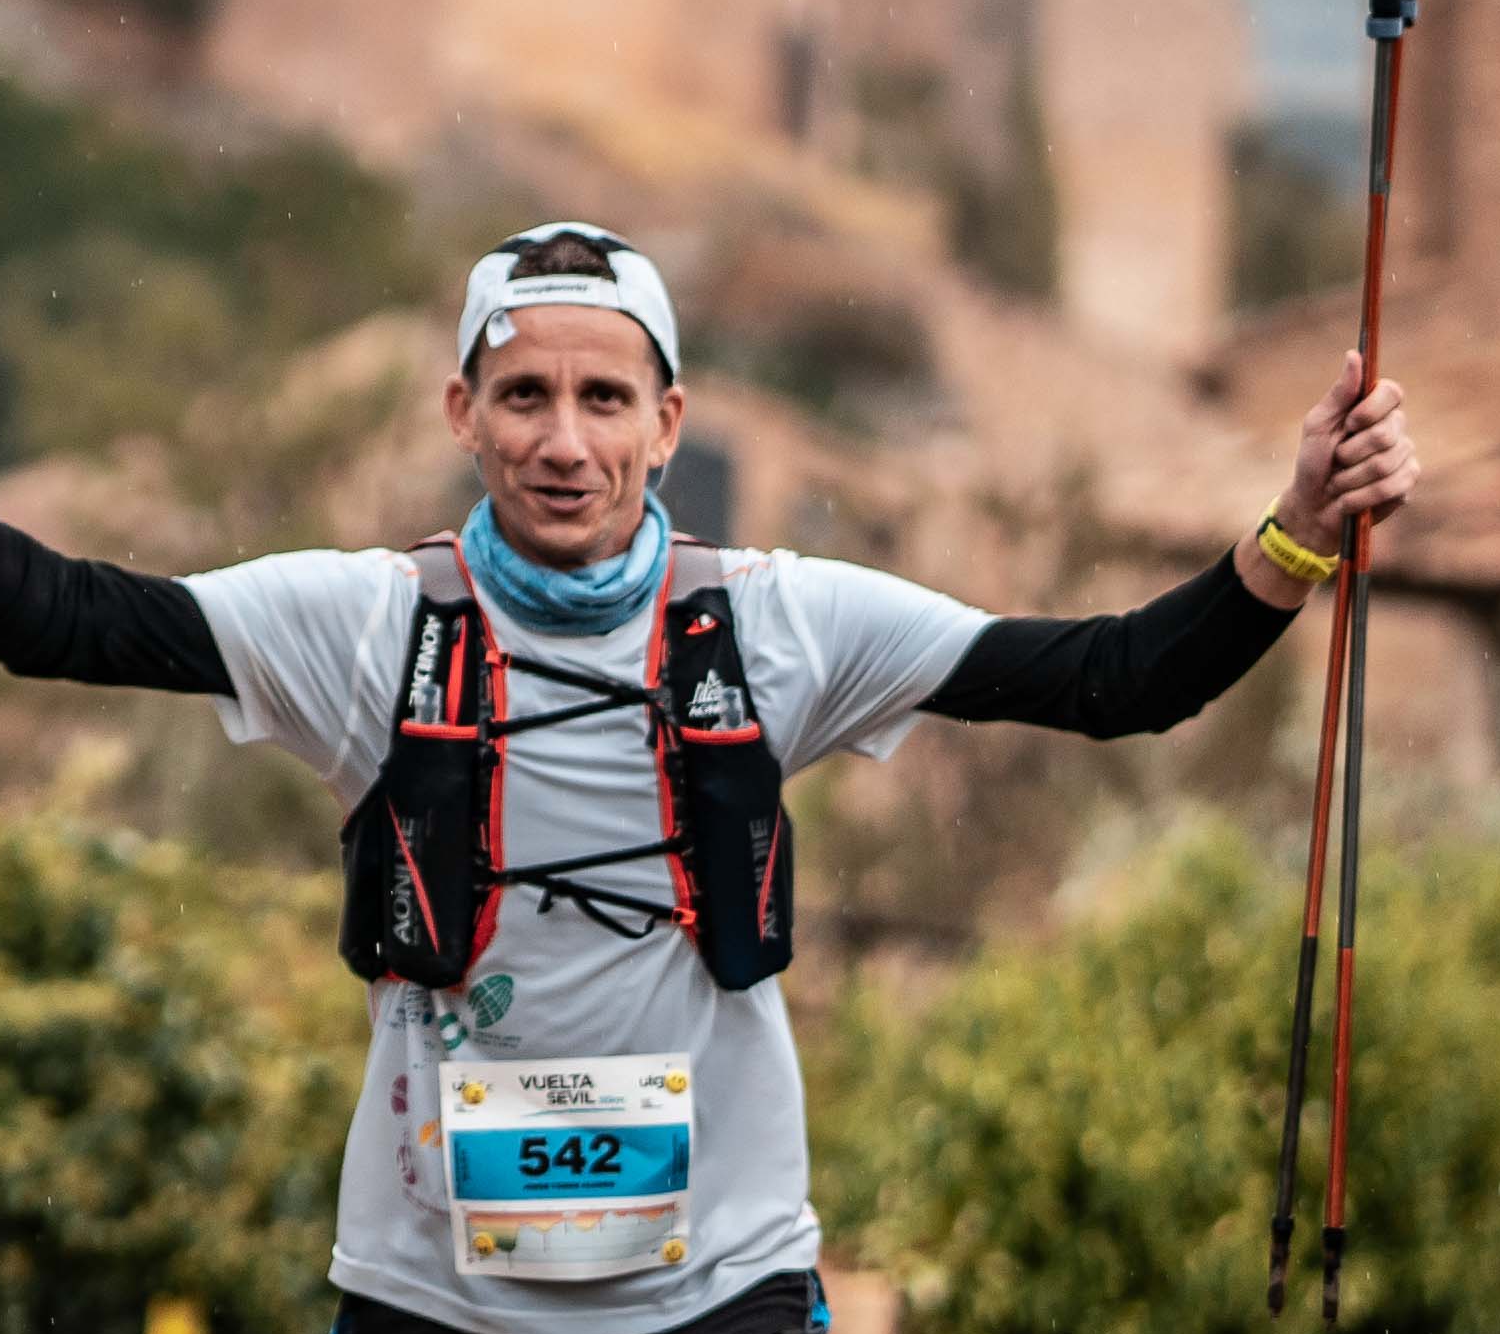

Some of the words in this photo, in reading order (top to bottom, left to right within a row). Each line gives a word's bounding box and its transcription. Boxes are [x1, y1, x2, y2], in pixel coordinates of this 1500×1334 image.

[518, 1074, 593, 1090] VUELTA
[546, 1090, 595, 1105] SEVIL
[518, 1134, 622, 1176] 542
